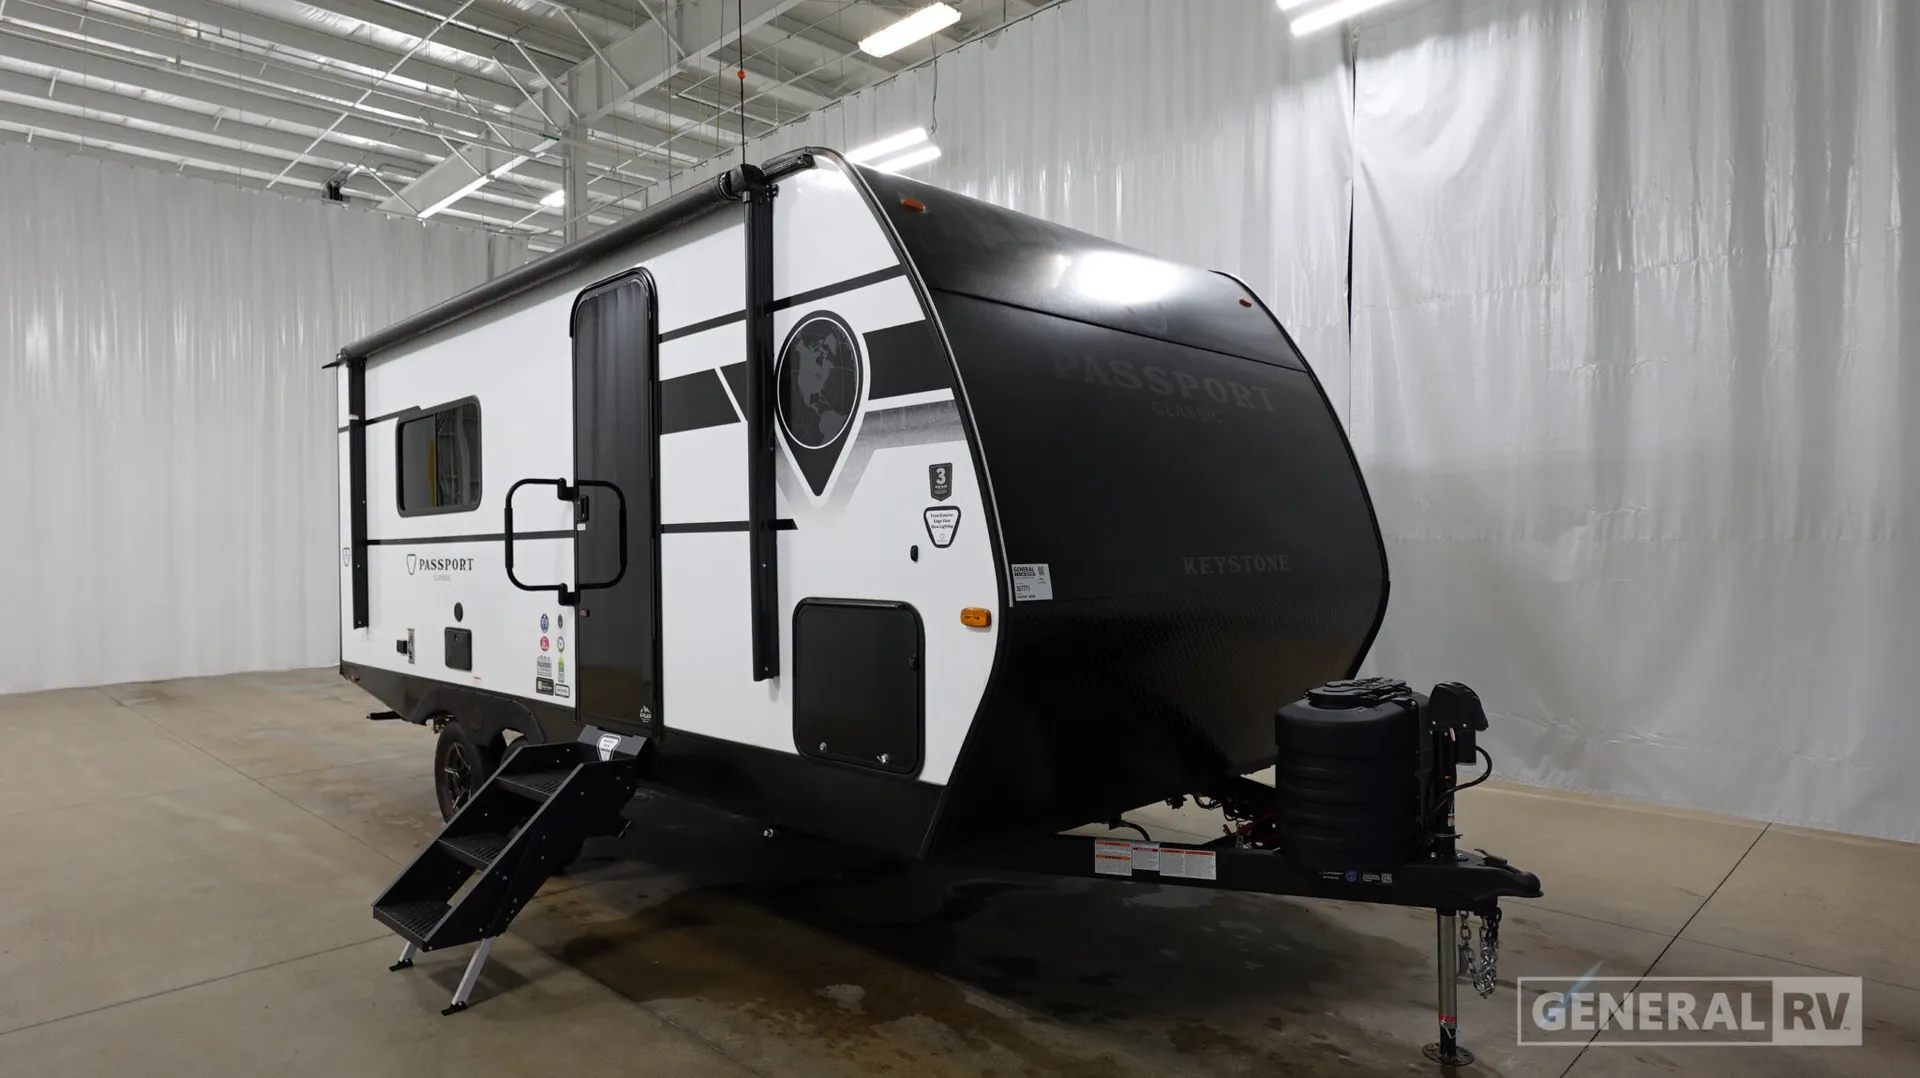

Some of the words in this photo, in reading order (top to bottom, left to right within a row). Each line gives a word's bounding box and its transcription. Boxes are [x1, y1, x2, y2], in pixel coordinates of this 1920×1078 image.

[1052, 351, 1276, 412] PASSPORT
[1152, 401, 1223, 424] CLASSIC
[936, 467, 946, 484] 3
[419, 558, 474, 571] PASSPORT
[1181, 553, 1290, 575] KEYSTONE
